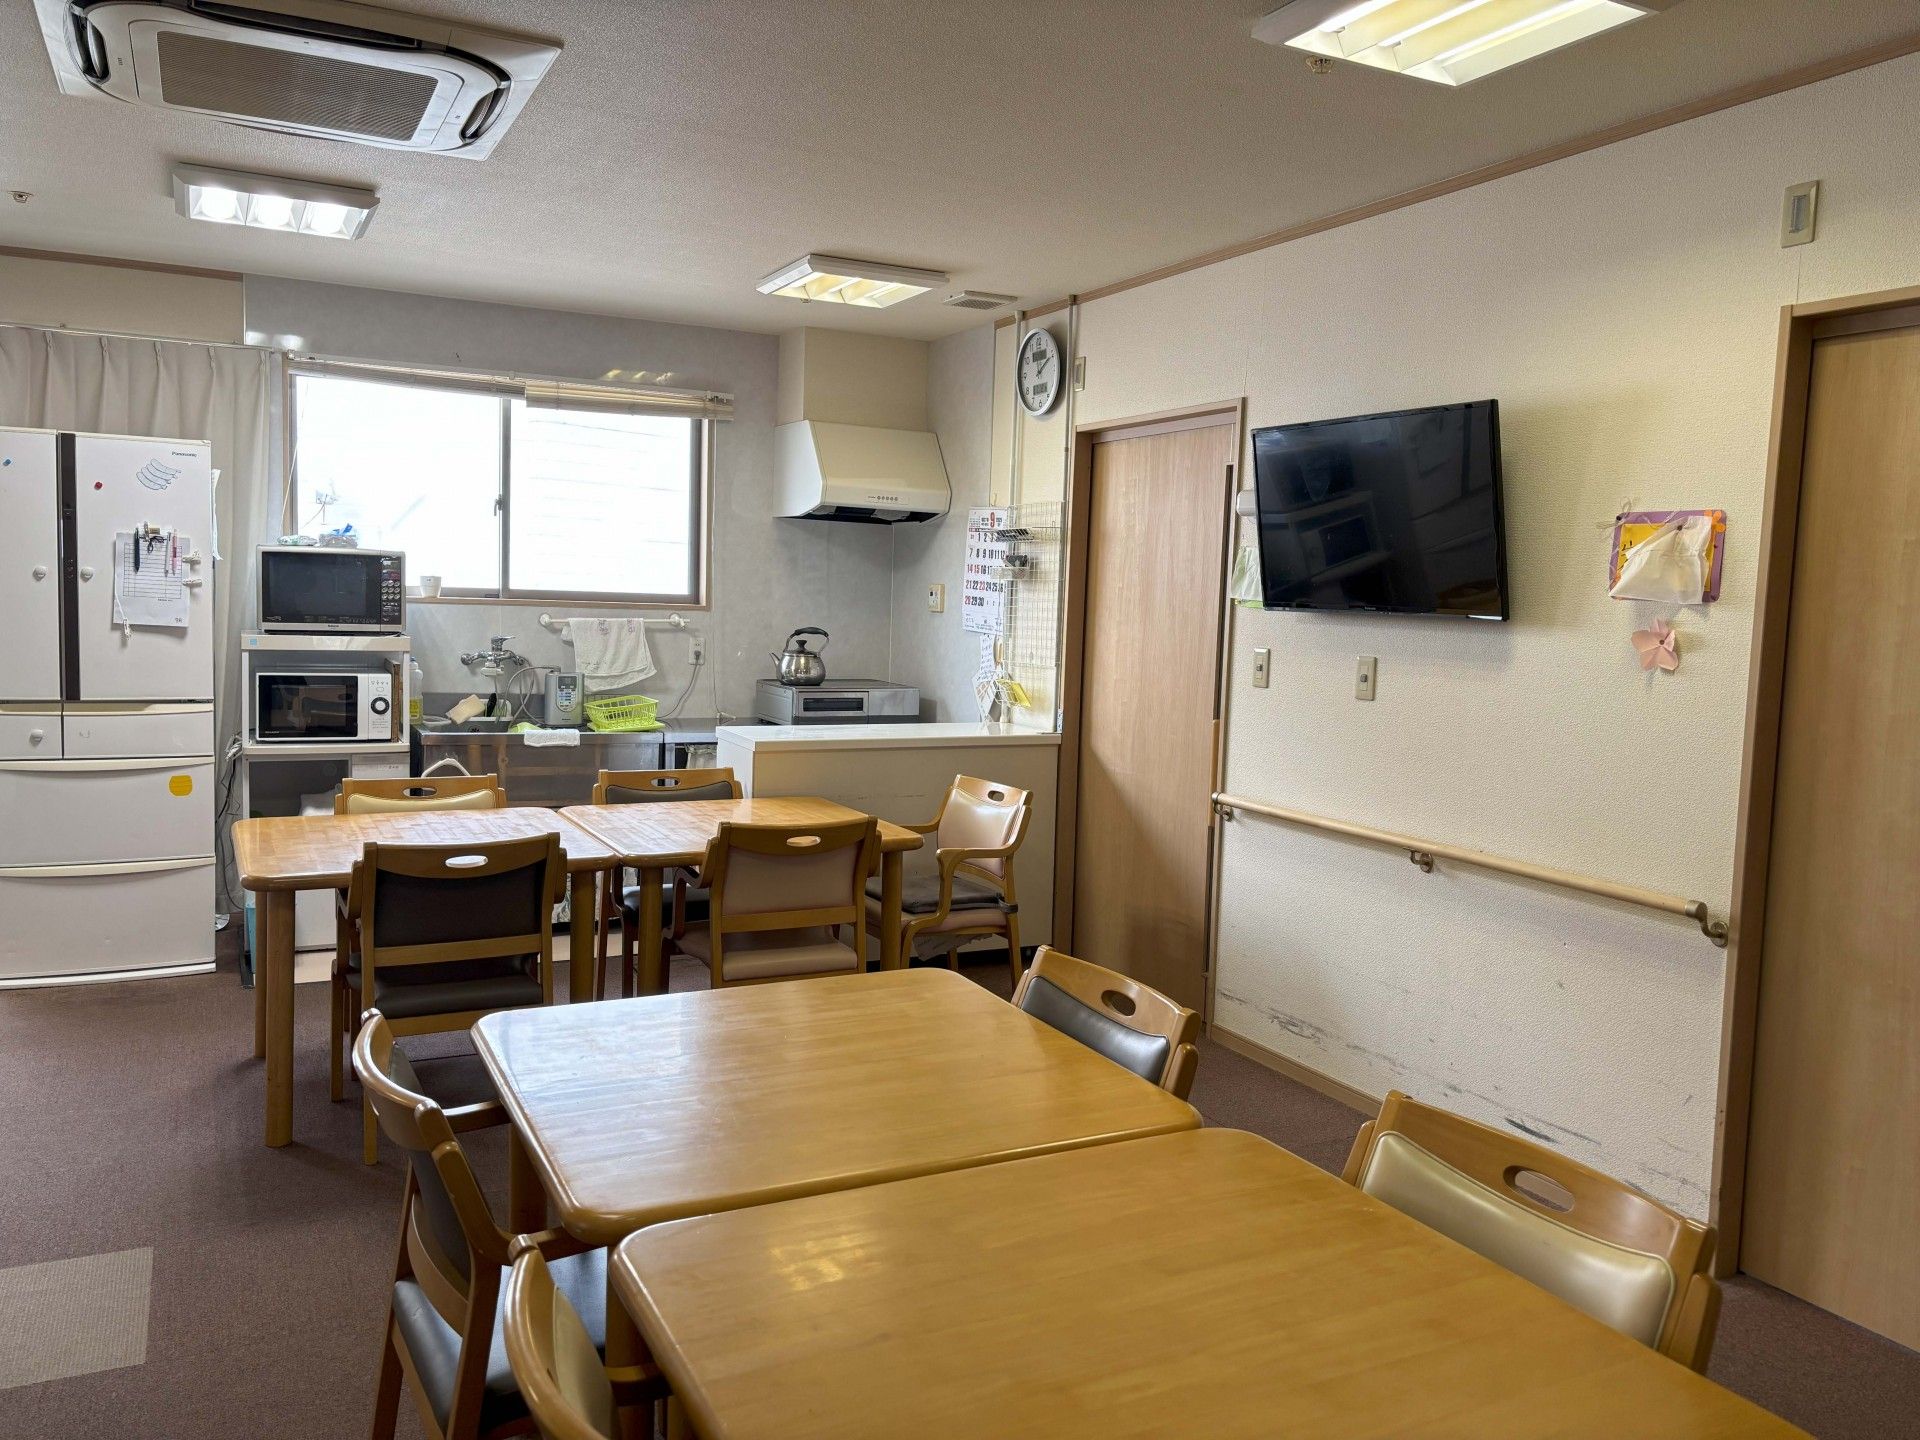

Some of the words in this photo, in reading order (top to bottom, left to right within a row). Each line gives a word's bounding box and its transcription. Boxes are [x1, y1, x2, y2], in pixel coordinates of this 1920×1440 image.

[990, 512, 995, 528] 9
[970, 548, 974, 558] 7
[976, 548, 980, 558] 8
[982, 549, 986, 558] 9
[988, 550, 994, 559] 10
[994, 550, 999, 560] 11
[1000, 550, 1005, 560] 12
[967, 564, 973, 574] 14
[974, 564, 979, 574] 15
[981, 565, 986, 574] 16
[966, 580, 971, 589] 21
[972, 580, 978, 590] 22
[979, 581, 985, 591] 23
[986, 582, 991, 591] 24
[992, 582, 997, 592] 25
[971, 596, 978, 606] 29
[978, 597, 984, 607] 30
